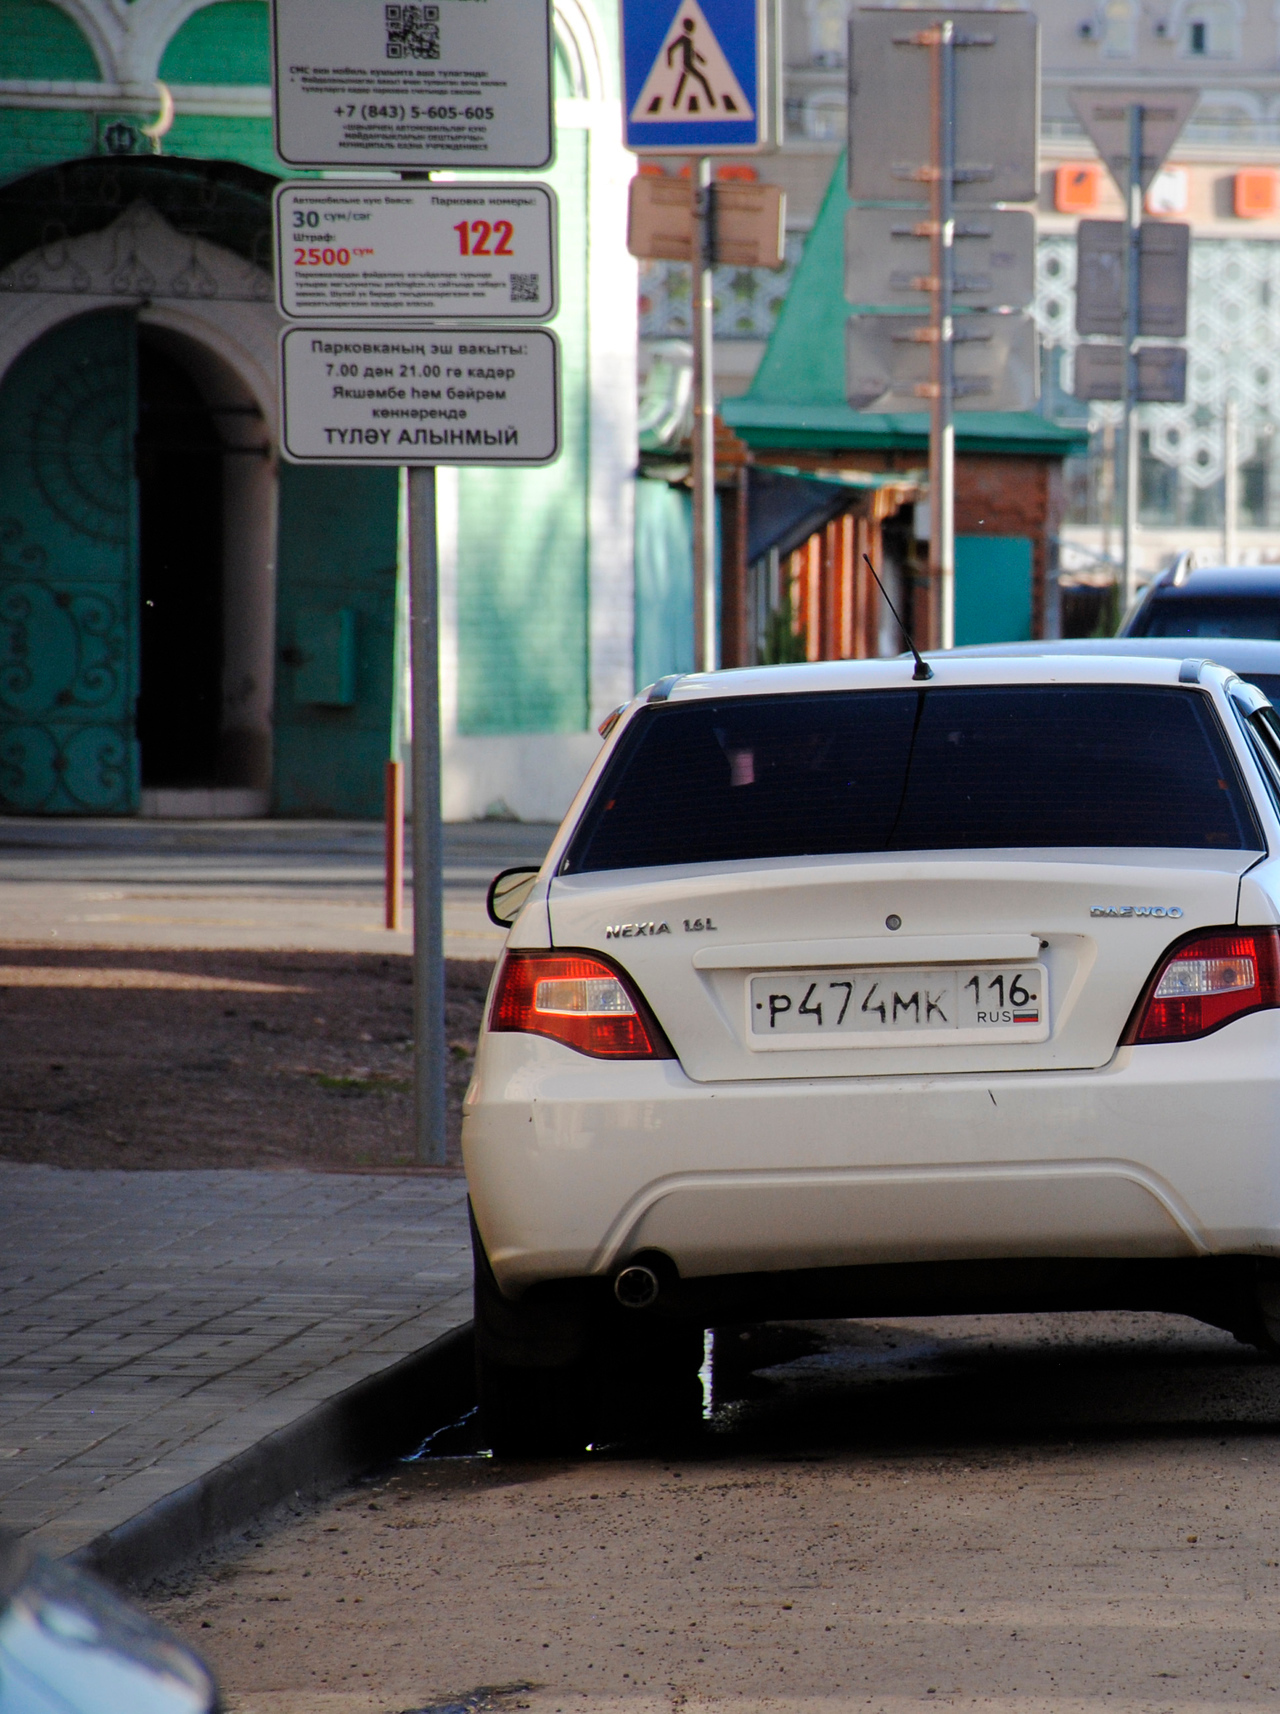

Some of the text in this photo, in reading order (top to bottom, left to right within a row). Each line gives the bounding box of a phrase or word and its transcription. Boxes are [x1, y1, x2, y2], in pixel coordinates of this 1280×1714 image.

[334, 105, 494, 121] +7 (843) 5-605-605
[431, 196, 537, 208] Парковка номеры:
[293, 211, 320, 228] 30
[293, 233, 336, 243] Штраф:
[453, 220, 514, 256] 122
[294, 248, 351, 266] 2500
[311, 340, 528, 356] Парковканың эш вакыты:
[326, 363, 516, 381] 7.00 дән 21.00 гә кадәр
[332, 386, 507, 402] Якшәмбе һәм бәйрәм
[324, 425, 518, 446] ТҮЛӘҮ АЛЫНМЫЙ
[1090, 905, 1183, 919] DAEWOO
[606, 921, 672, 939] NEXIA
[769, 974, 1030, 1028] Р474МК 116
[977, 1011, 1012, 1023] RUS
